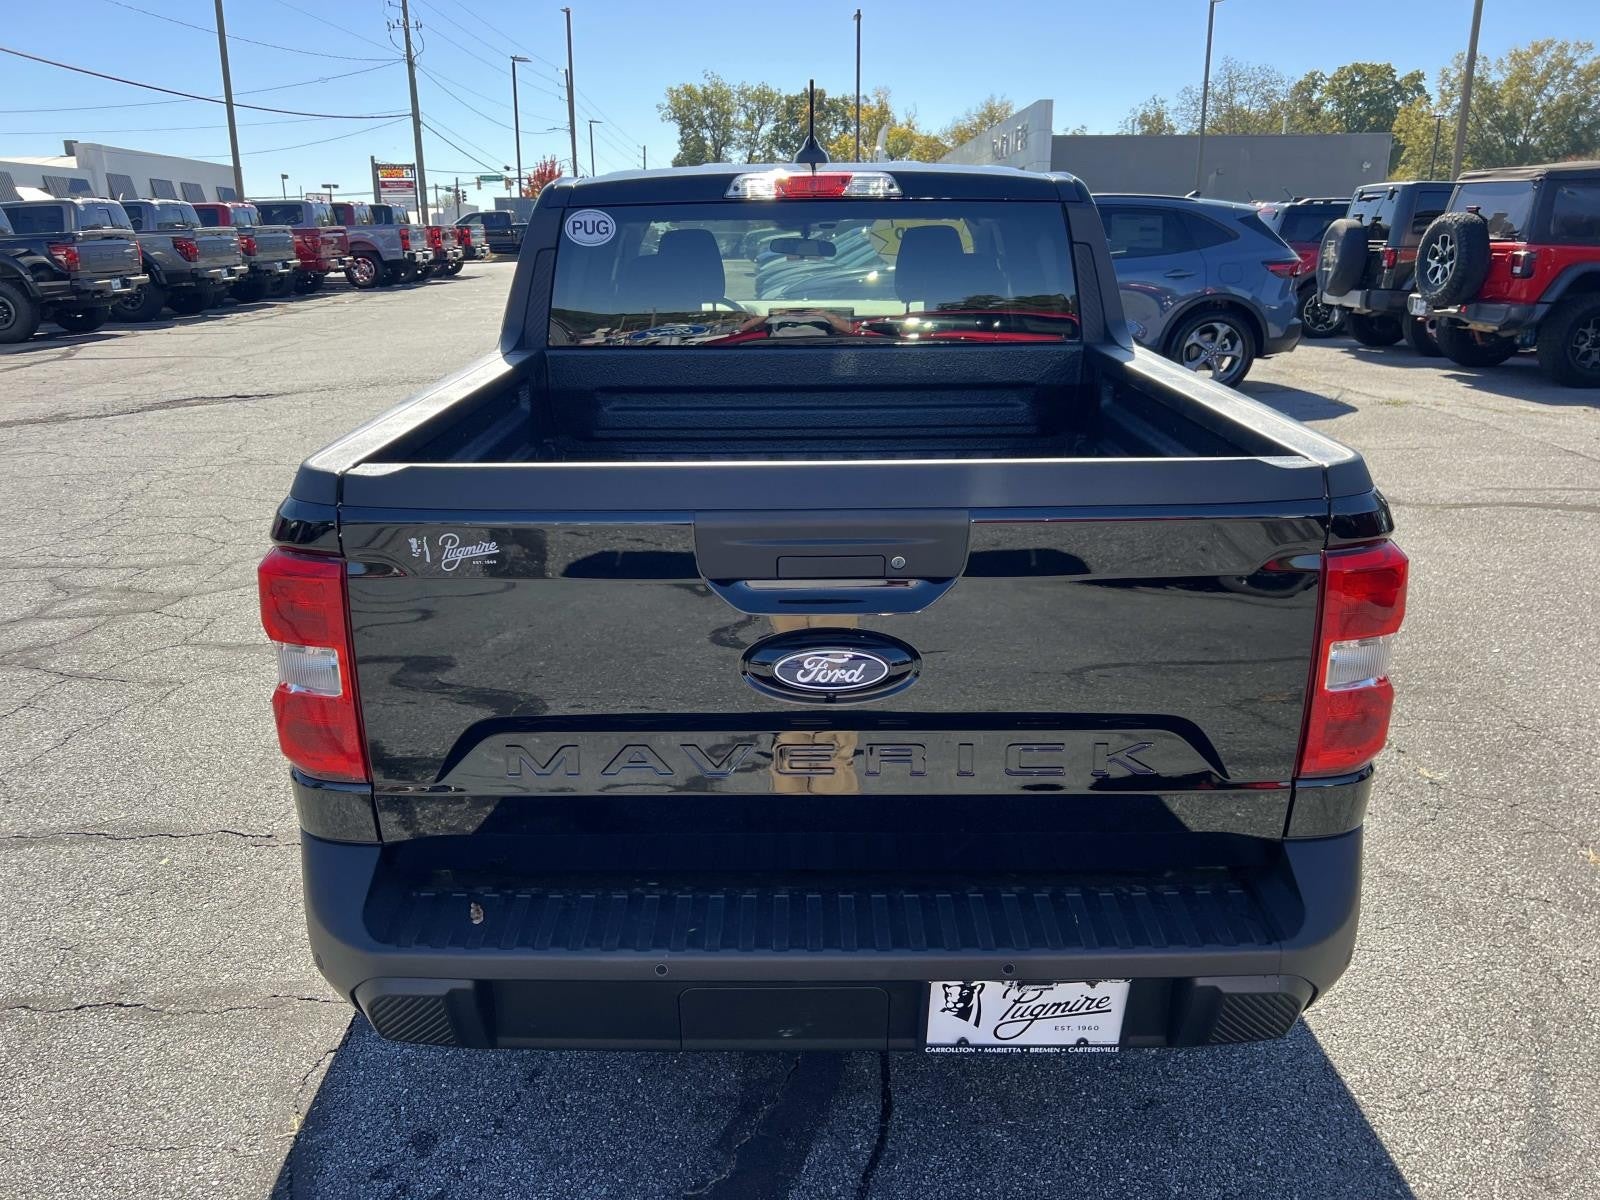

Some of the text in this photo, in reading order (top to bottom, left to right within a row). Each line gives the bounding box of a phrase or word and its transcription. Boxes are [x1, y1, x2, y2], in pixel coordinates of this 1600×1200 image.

[572, 220, 609, 235] PUG
[439, 533, 499, 571] Pugmire
[797, 656, 865, 683] Ford
[505, 742, 1156, 777] MAVERICK
[993, 986, 1111, 1040] Pugmire
